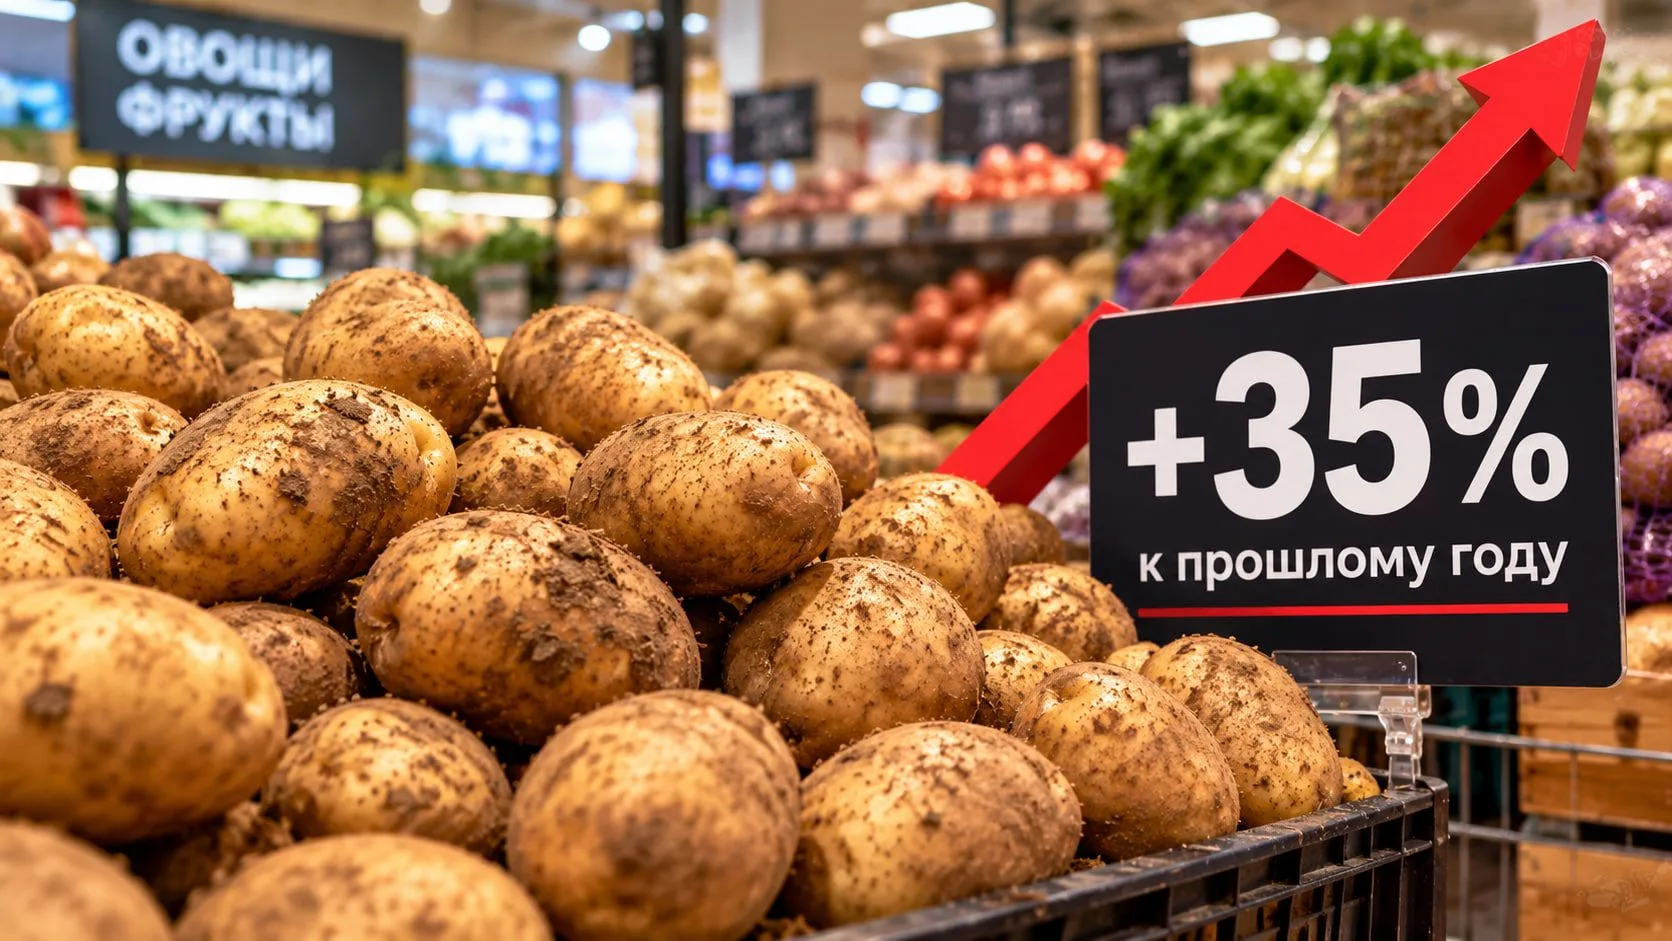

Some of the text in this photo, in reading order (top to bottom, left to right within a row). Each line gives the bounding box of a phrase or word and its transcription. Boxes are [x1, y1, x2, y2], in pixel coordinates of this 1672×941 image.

[117, 19, 333, 97] ОВОЩИ
[117, 81, 334, 152] ФРУКТЫ
[1127, 338, 1569, 520] +35%
[1139, 541, 1569, 591] к прошлому году
